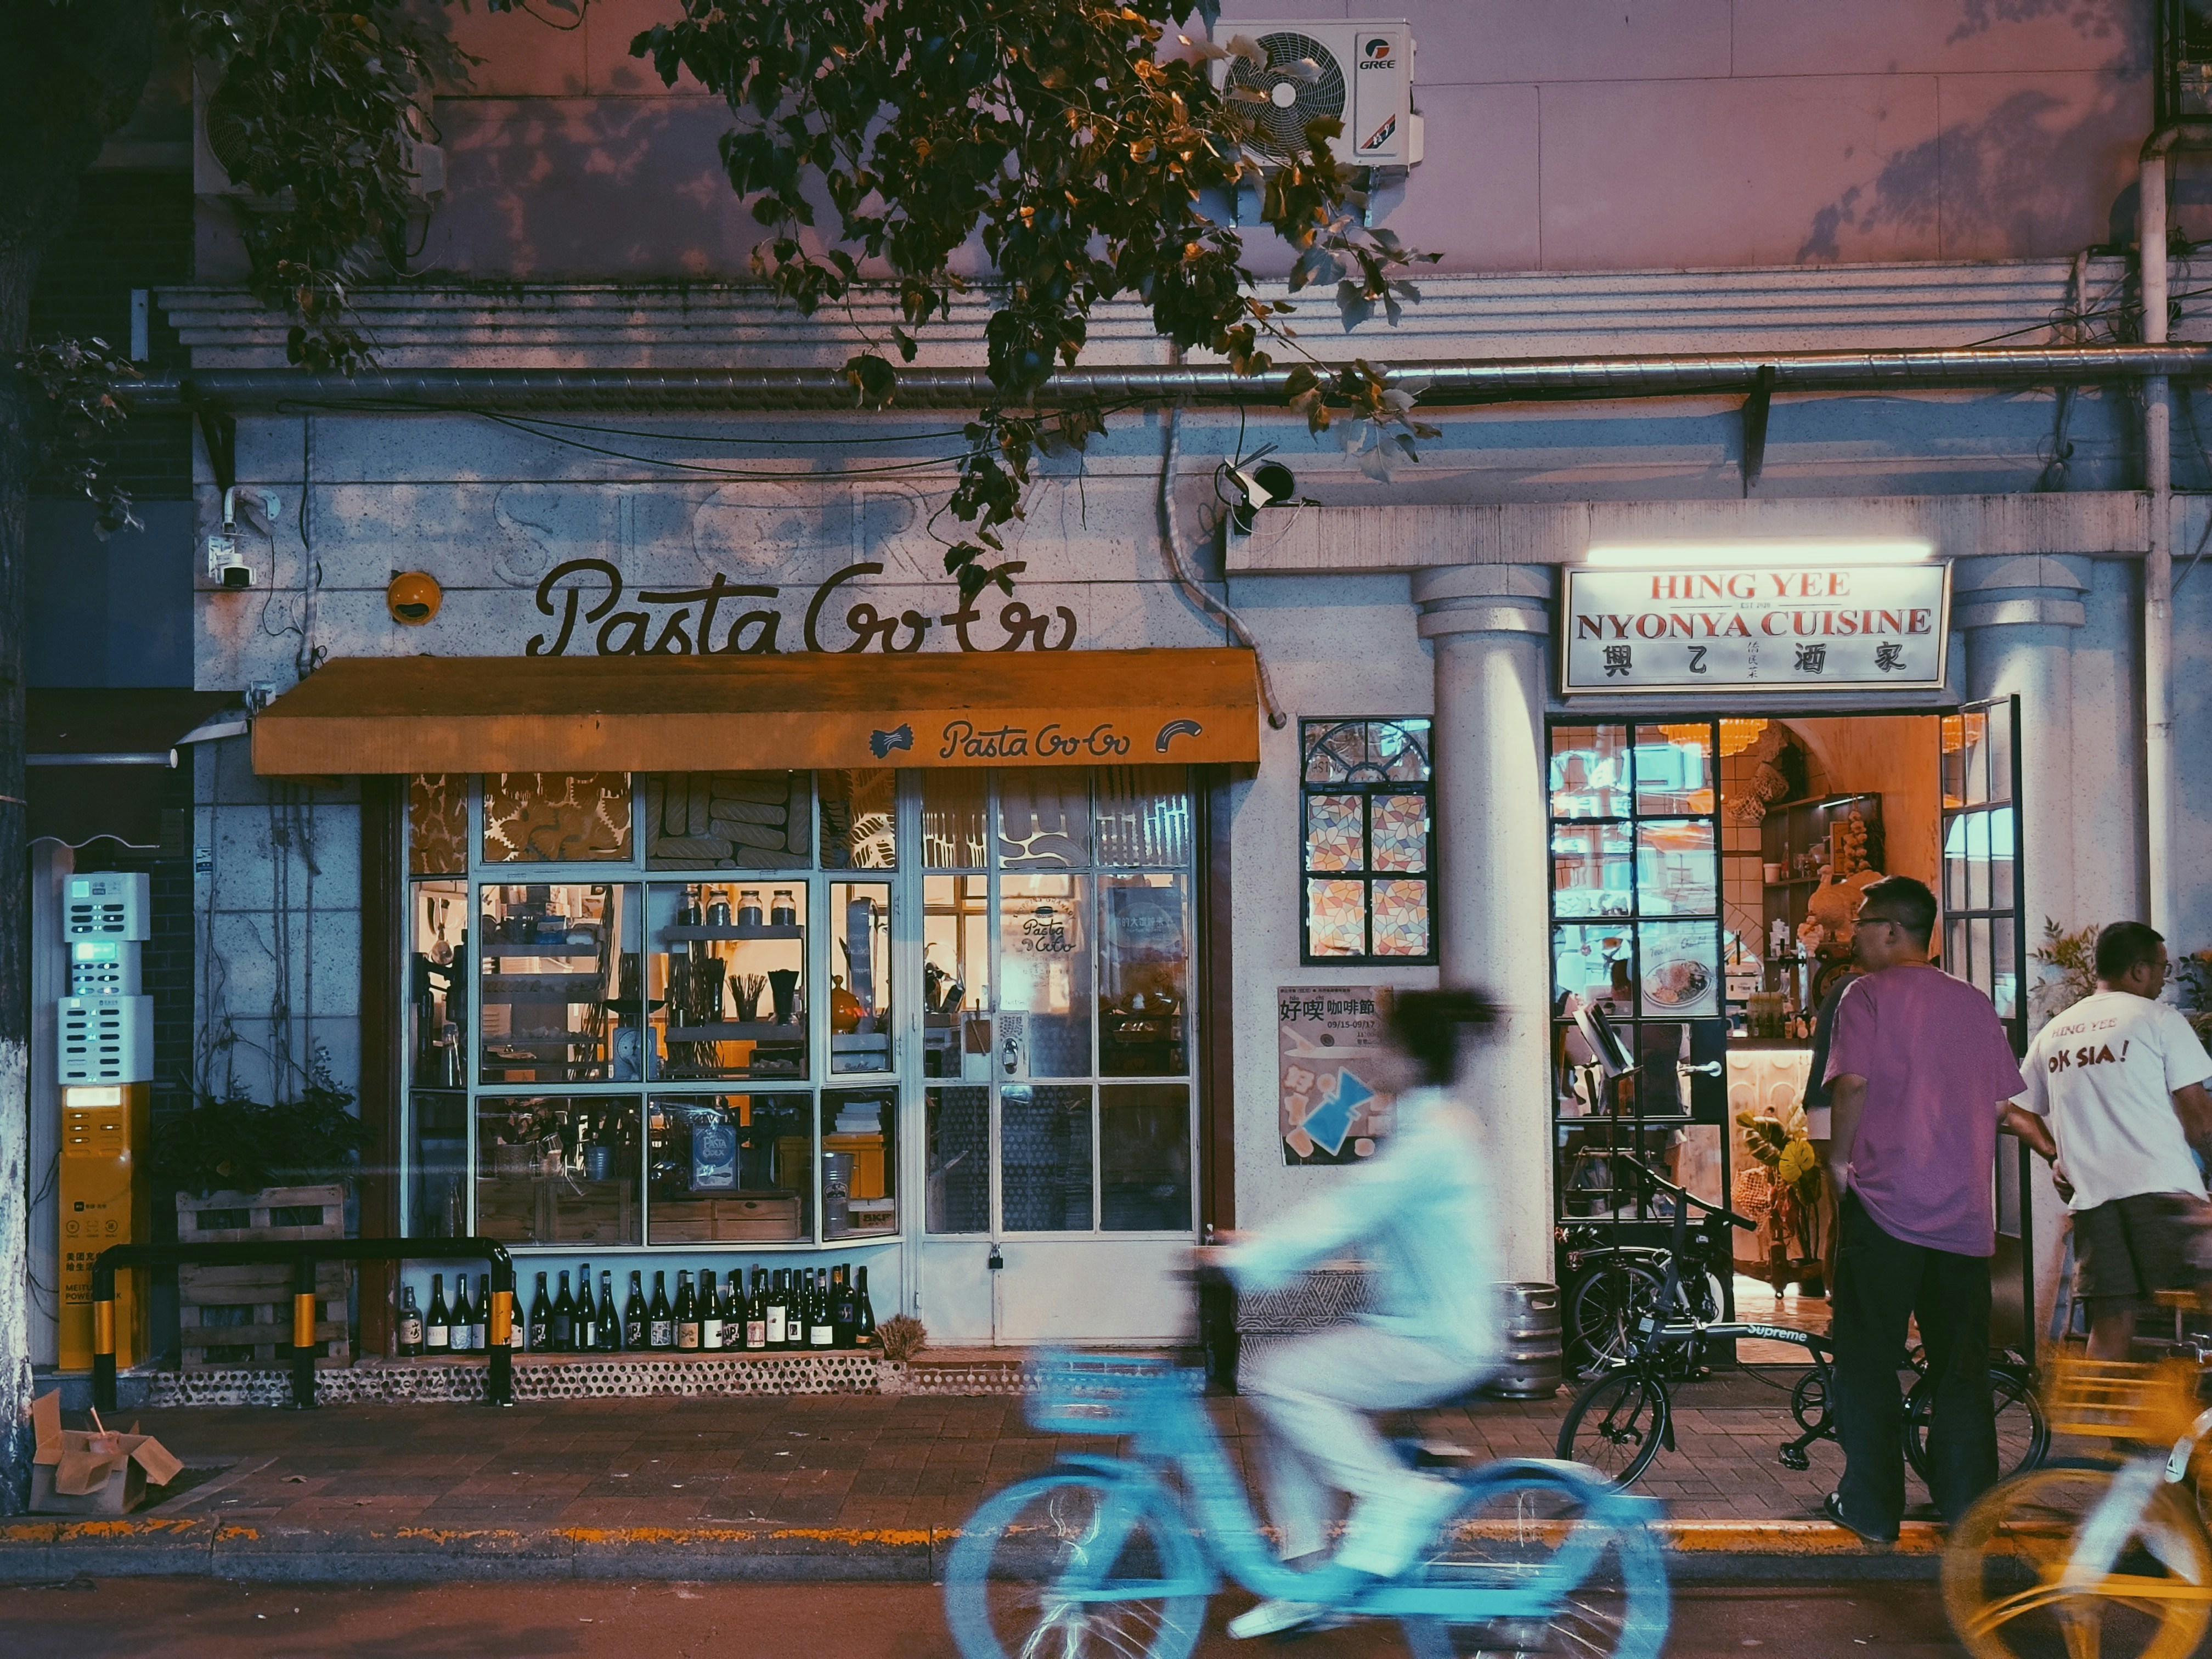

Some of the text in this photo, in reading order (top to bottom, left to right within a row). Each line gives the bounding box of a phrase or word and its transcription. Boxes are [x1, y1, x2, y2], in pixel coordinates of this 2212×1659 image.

[1359, 60, 1396, 70] GREE
[1650, 572, 1851, 600] HING YEE
[525, 557, 782, 657] Pasta
[1576, 608, 1932, 640] NYONYA CUISINE
[939, 720, 1028, 759] Pasta
[1023, 918, 1064, 936] Pasta
[1280, 999, 1375, 1022] 好喫 咖啡節
[1327, 1020, 1375, 1029] 09/15-09/17
[2051, 1017, 2118, 1039] HING YEE
[2049, 1048, 2071, 1074] OK
[1747, 1324, 1808, 1342] Supreme
